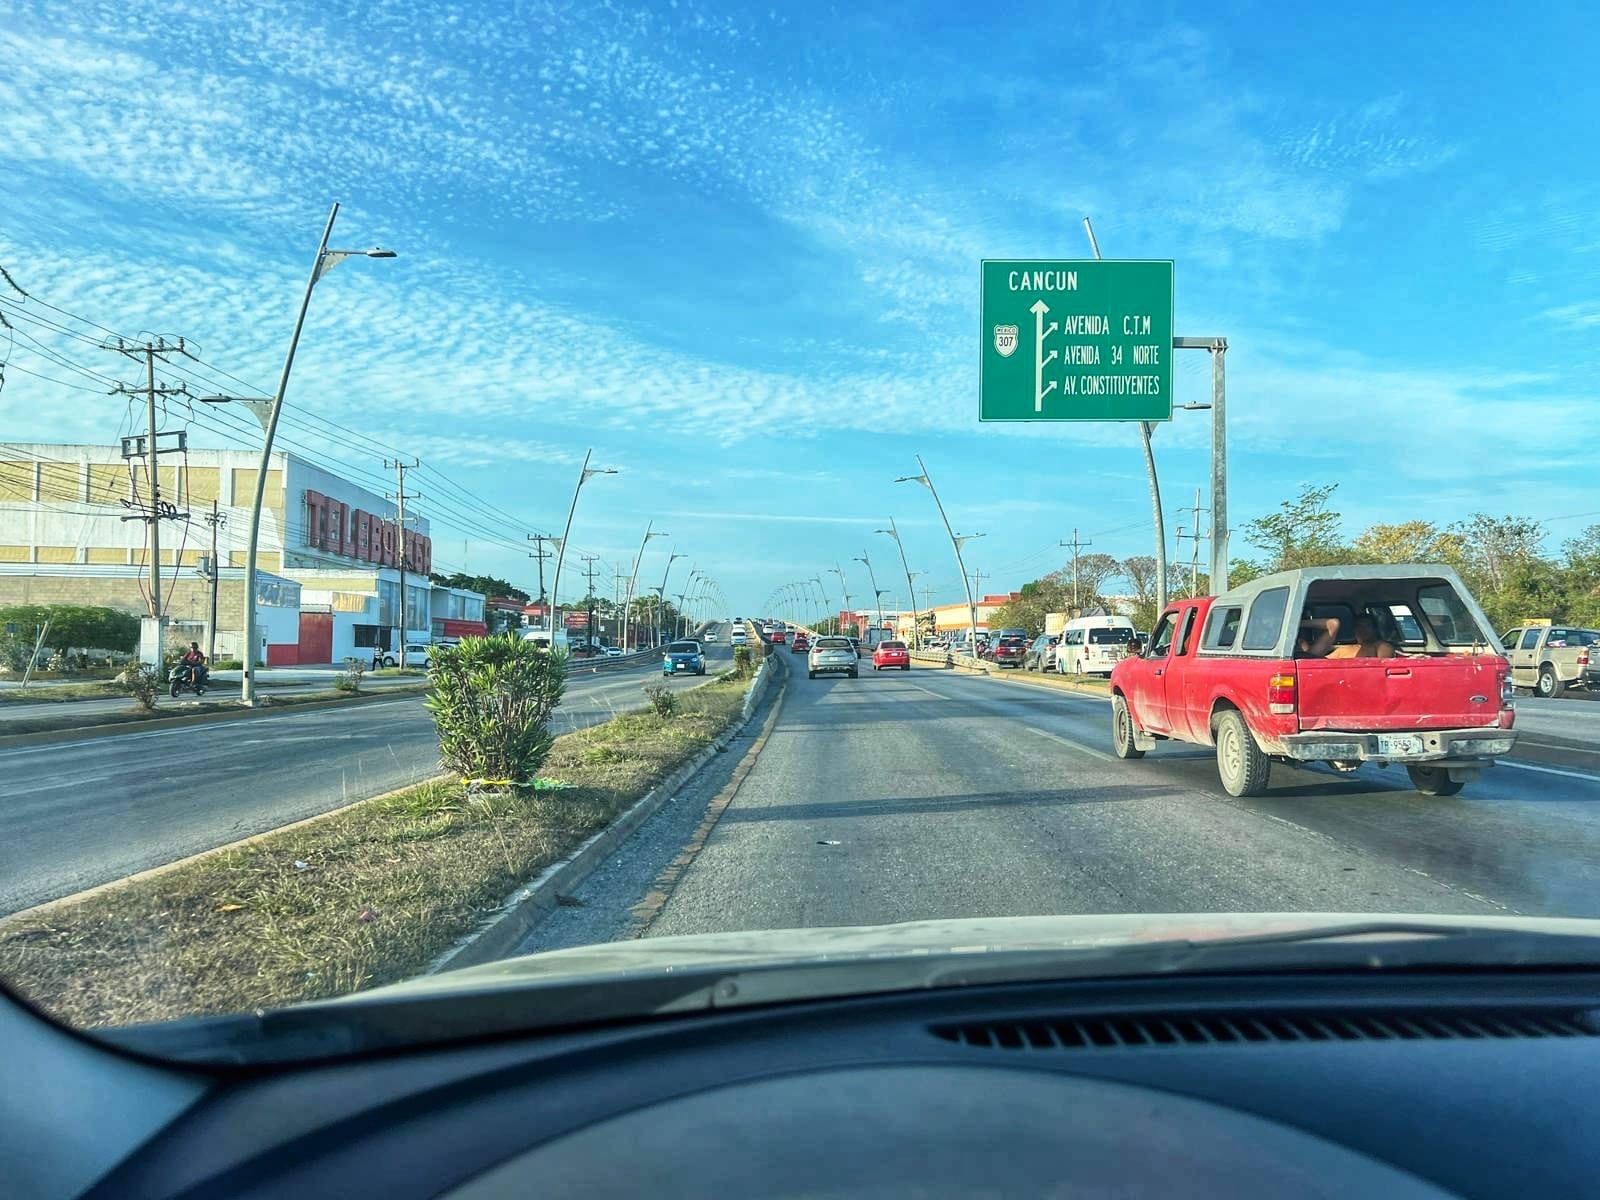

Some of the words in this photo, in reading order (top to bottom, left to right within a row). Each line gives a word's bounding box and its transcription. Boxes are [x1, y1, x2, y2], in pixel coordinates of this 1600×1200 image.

[1008, 271, 1078, 291] CANCUN
[1064, 315, 1109, 335] AVENIDA
[998, 336, 1014, 347] 307
[1064, 345, 1100, 365] AVENIDA
[1111, 345, 1123, 365] 34
[1133, 345, 1159, 365] NORTE
[1063, 375, 1078, 395] AV.
[1080, 375, 1160, 395] CONSTITUYENTES
